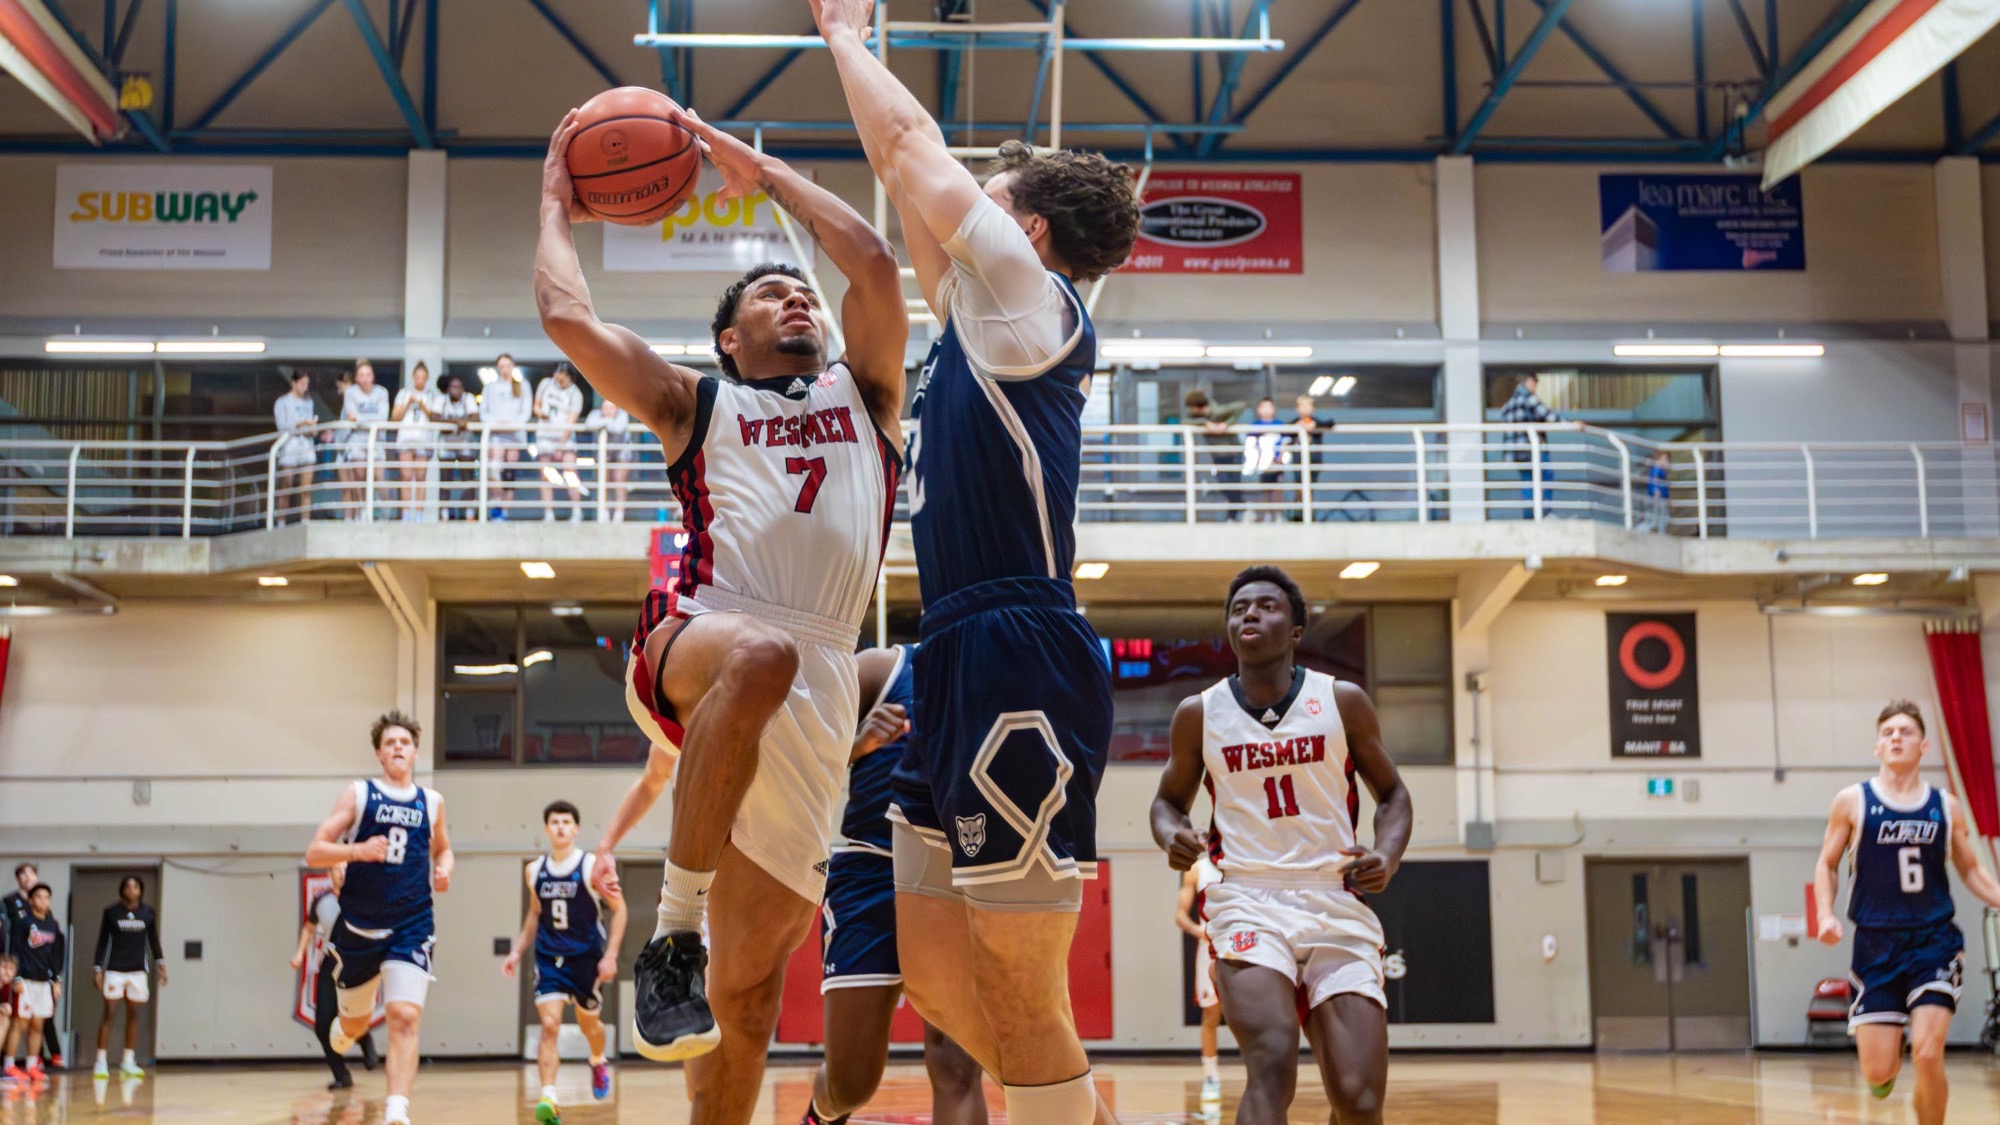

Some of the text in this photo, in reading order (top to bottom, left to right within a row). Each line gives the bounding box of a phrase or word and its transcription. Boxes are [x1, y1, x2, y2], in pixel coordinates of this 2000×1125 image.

[69, 189, 258, 223] SUBWAY
[662, 189, 793, 243] por
[737, 405, 859, 449] WESMEN
[785, 456, 828, 514] 7
[1221, 734, 1326, 773] WESMEN
[1263, 773, 1300, 819] 11
[386, 826, 408, 864] 8
[1877, 820, 1939, 845] MRU
[1898, 846, 1925, 893] 6
[551, 899, 569, 930] 9
